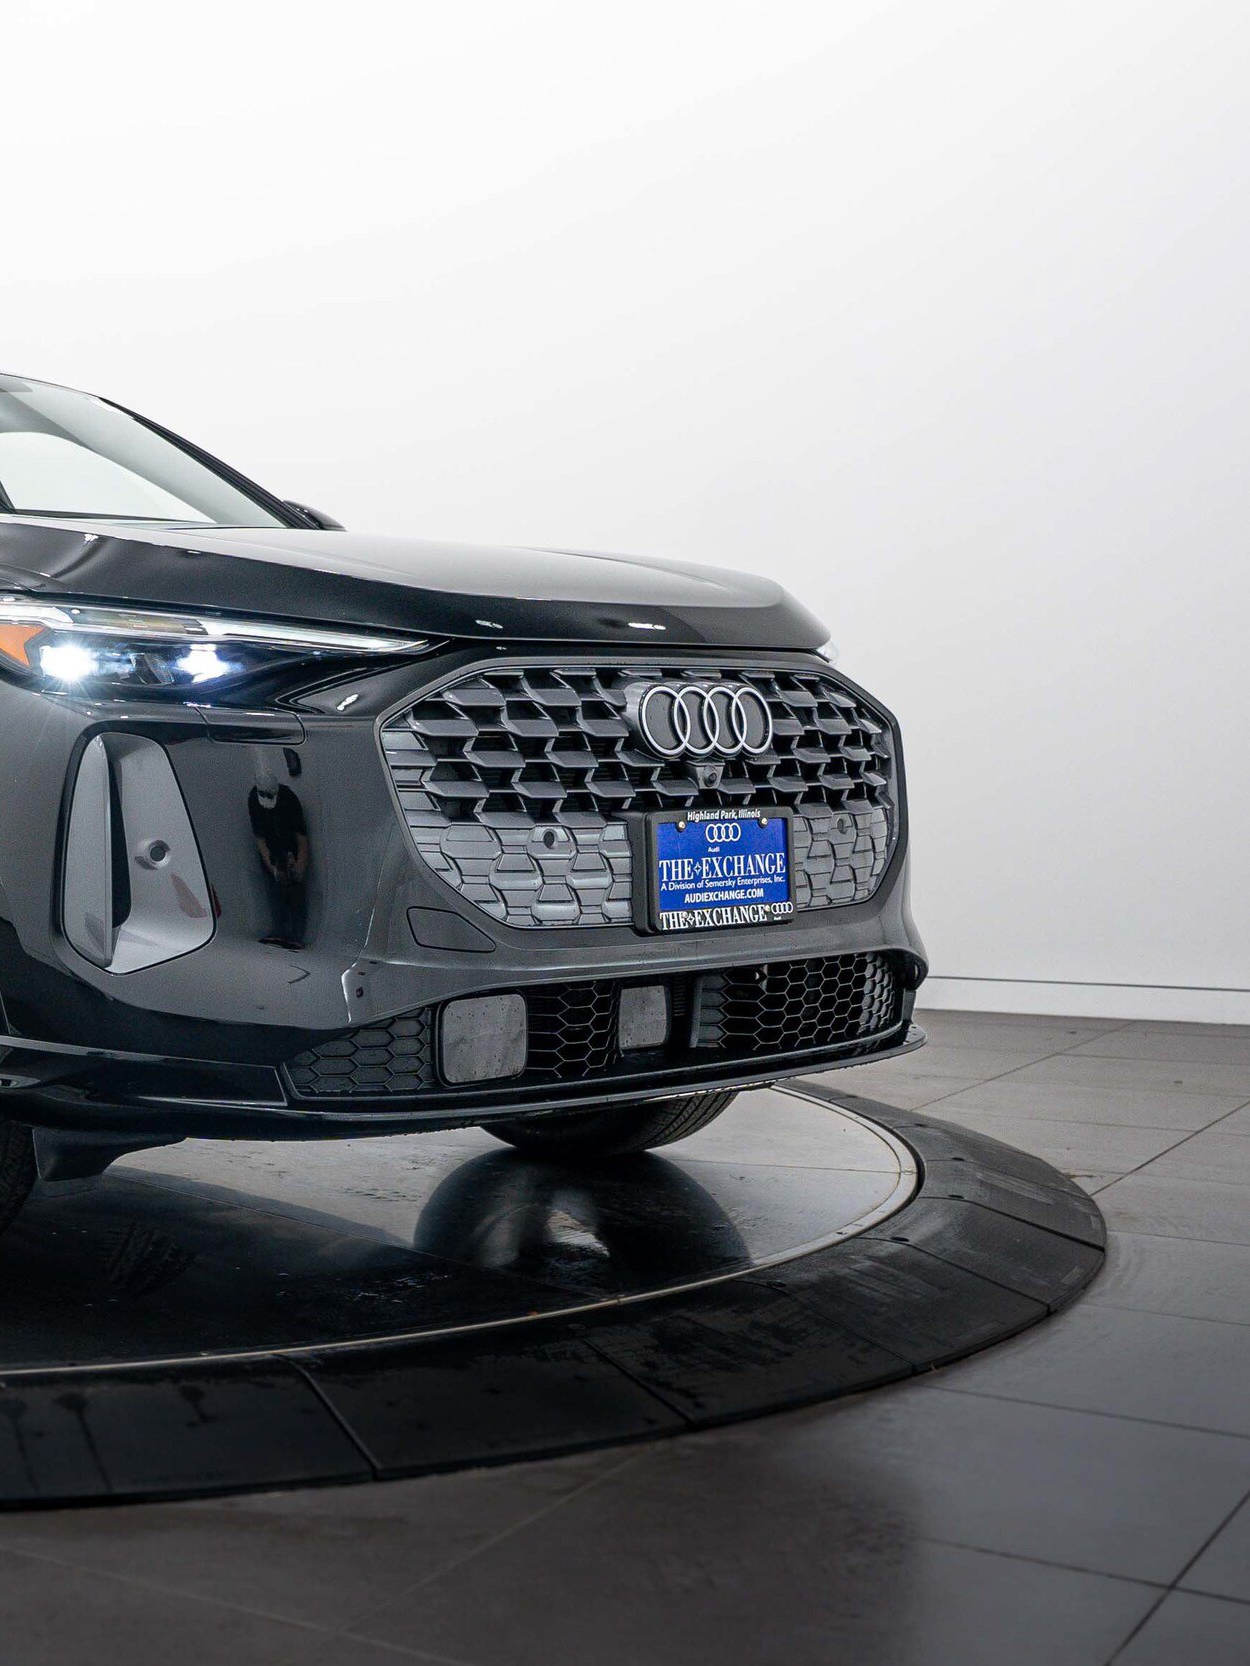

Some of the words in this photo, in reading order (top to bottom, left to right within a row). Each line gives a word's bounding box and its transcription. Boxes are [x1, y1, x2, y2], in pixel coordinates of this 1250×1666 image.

[687, 810, 719, 822] Highland
[721, 810, 737, 819] Park,
[739, 809, 760, 818] Illinois
[658, 858, 694, 882] THE
[701, 852, 786, 879] EXCHANGE
[661, 883, 667, 891] A
[669, 882, 695, 891] Division
[697, 880, 704, 888] of
[705, 879, 735, 888] Semersky
[684, 888, 763, 903] AUDIEXCHANGE.COM
[659, 910, 689, 931] THE
[693, 903, 768, 928] EXCHANGE
